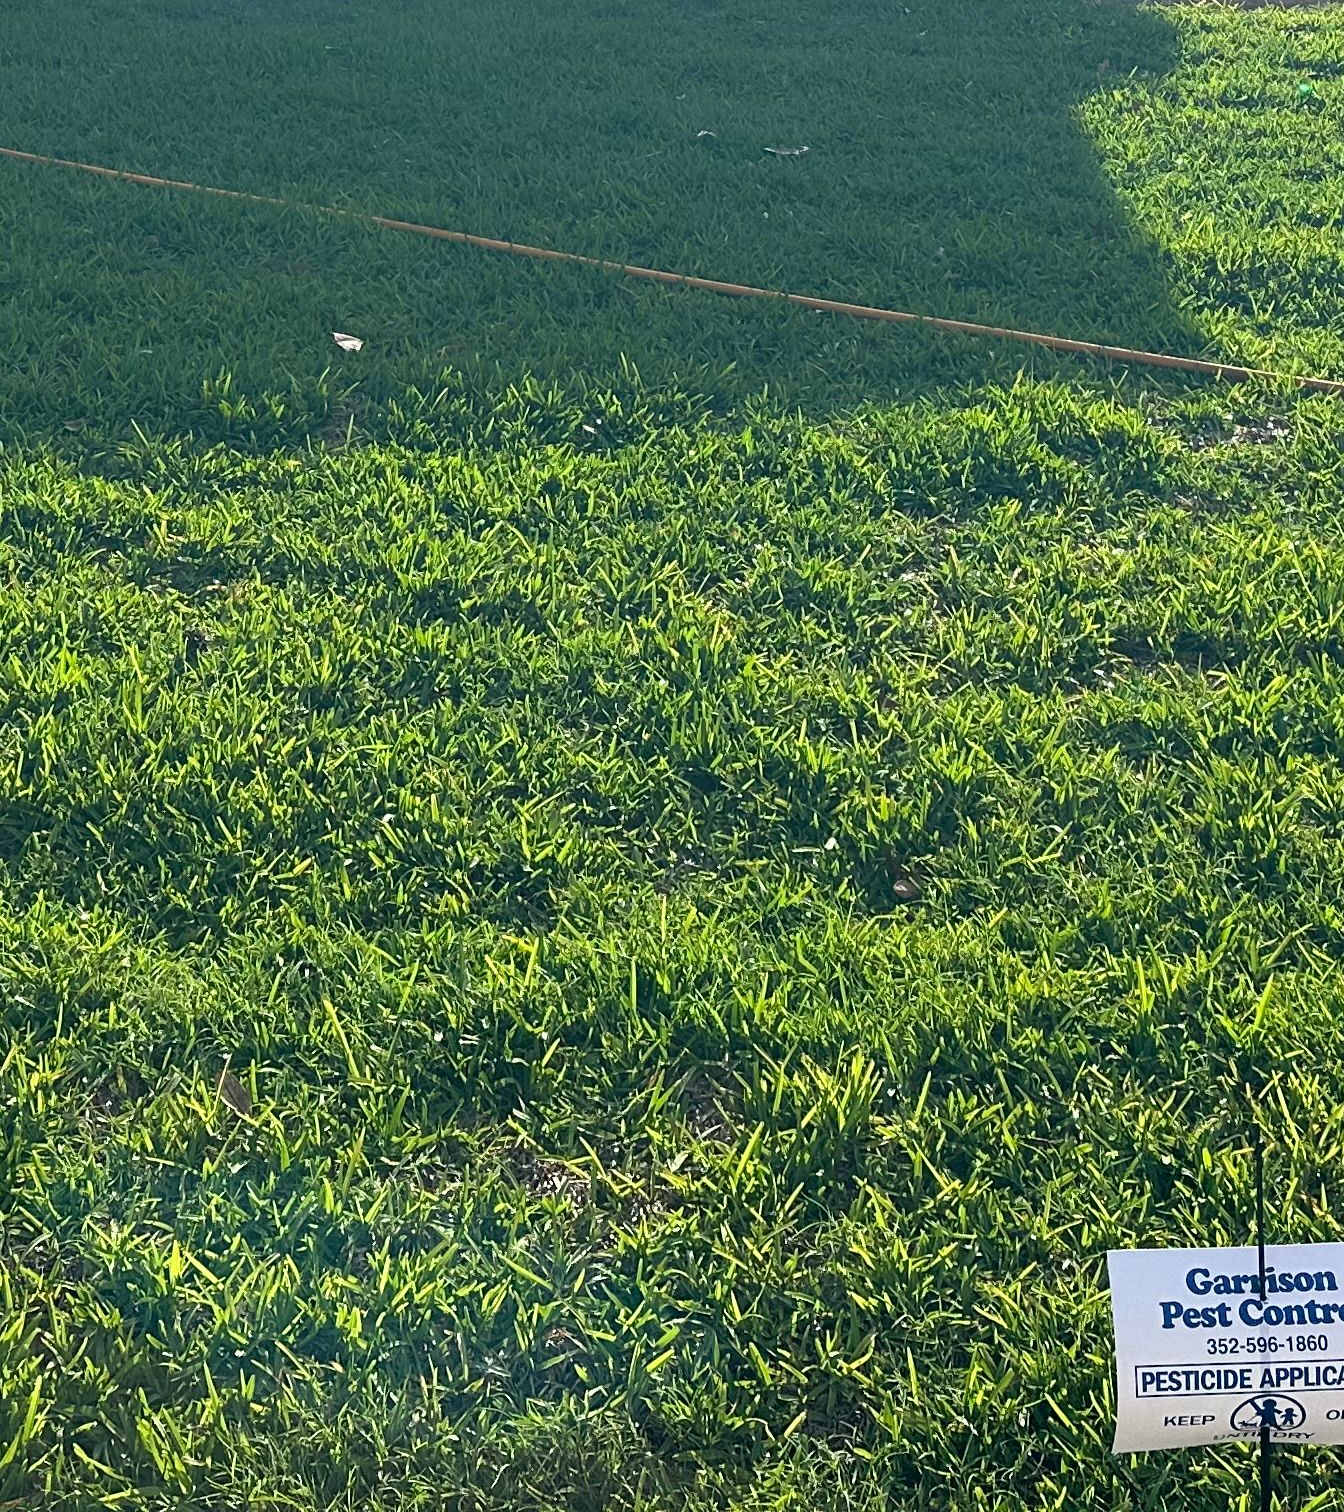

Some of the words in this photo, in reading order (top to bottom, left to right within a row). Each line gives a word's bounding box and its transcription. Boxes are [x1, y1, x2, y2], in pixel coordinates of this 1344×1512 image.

[1185, 1266, 1339, 1295] Garrison
[1159, 1301, 1233, 1329] Pest
[1206, 1334, 1329, 1355] 352-596-1860
[1141, 1368, 1253, 1393] PESTICIDE
[1163, 1414, 1216, 1427] KEEP
[1272, 1431, 1316, 1439] DRY
